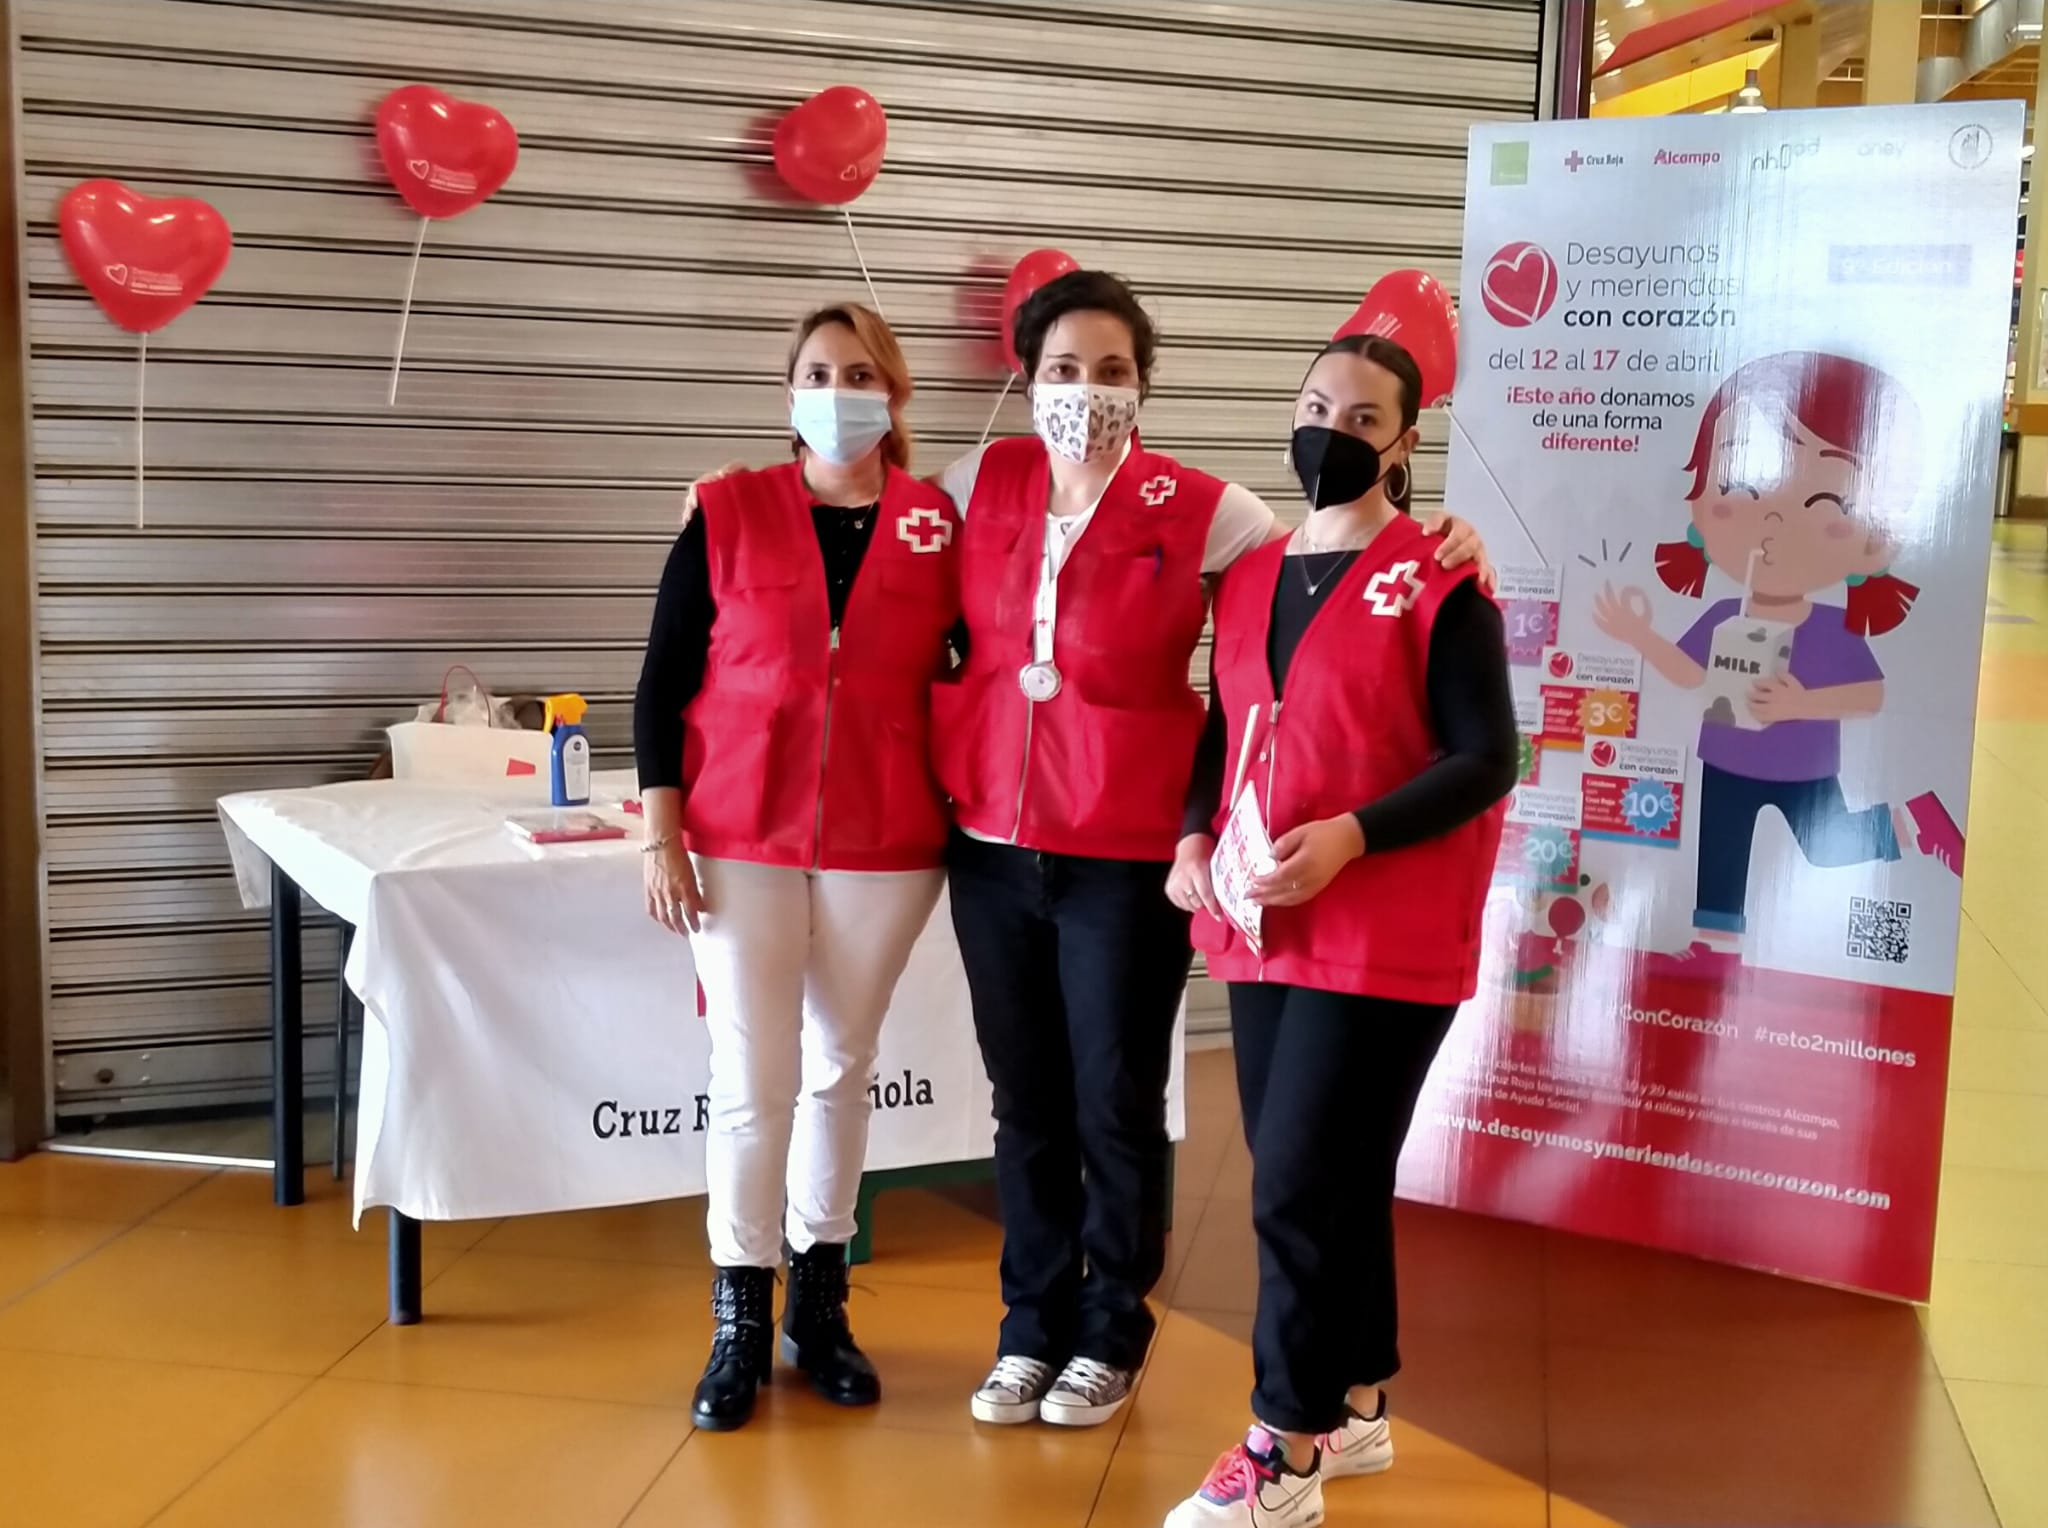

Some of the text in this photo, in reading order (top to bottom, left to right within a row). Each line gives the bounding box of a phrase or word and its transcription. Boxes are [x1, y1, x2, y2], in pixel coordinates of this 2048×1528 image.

[1586, 154, 1604, 165] Cruz
[1654, 148, 1721, 166] Alcampo
[1566, 242, 1720, 270] Desayunos
[1566, 273, 1740, 302] y meriendas
[1564, 302, 1736, 328] con corazón
[1488, 348, 1720, 372] del 12 al 17 de abril
[1506, 386, 1695, 408] ¡Este año donamos
[1532, 409, 1663, 430] de una forma
[1541, 432, 1640, 453] diferente!
[1714, 655, 1760, 674] MILK
[1588, 702, 1623, 727] 3€
[1639, 764, 1679, 776] corazón
[1626, 791, 1676, 818] 10€
[1526, 837, 1573, 864] 20€
[1754, 1025, 1916, 1068] #reto2millones
[1510, 1091, 1545, 1107] Ayuda
[592, 1100, 681, 1139] Cruz
[1783, 1107, 1840, 1129] Alcampo,
